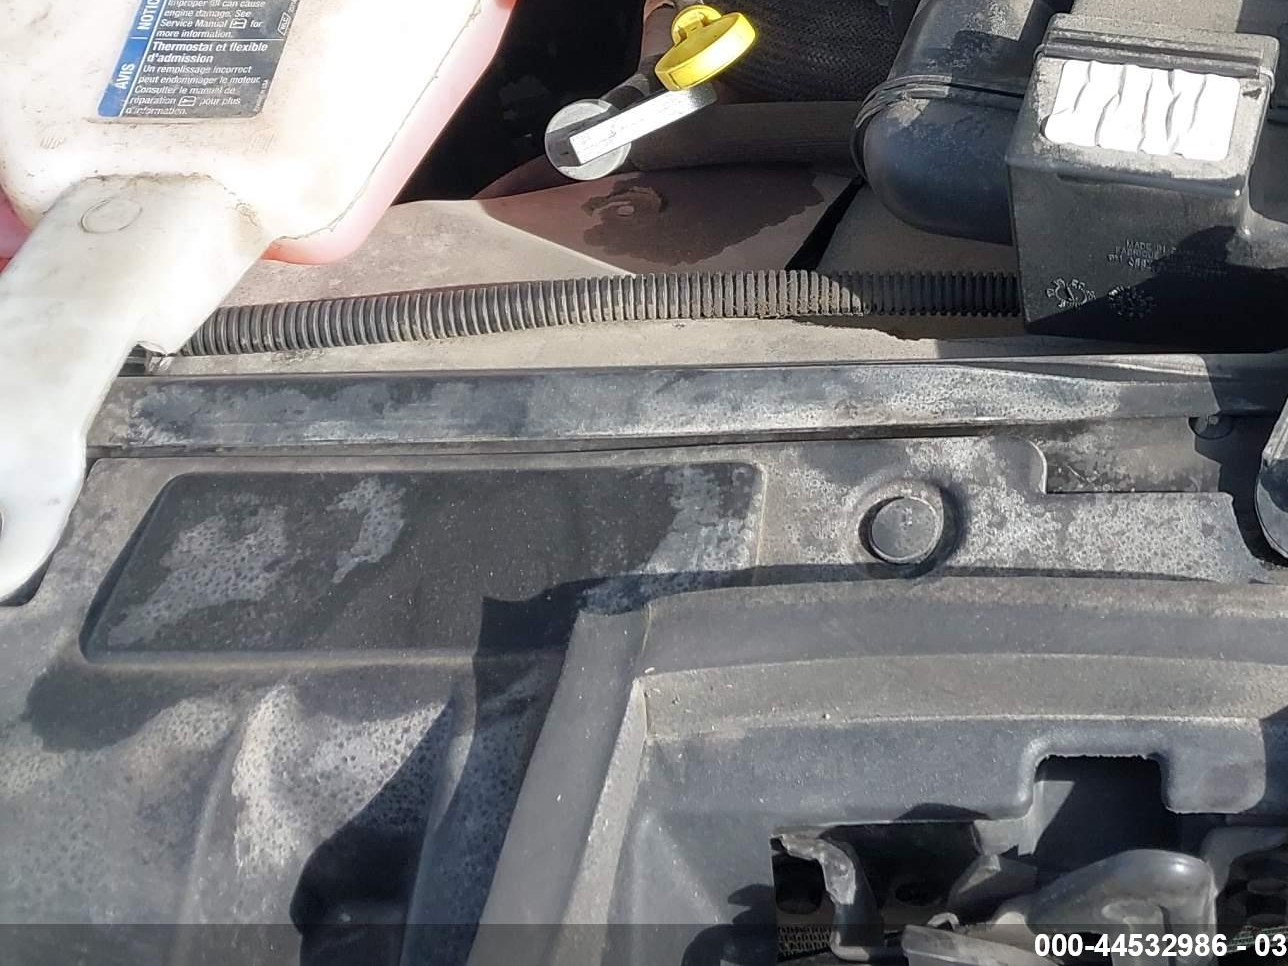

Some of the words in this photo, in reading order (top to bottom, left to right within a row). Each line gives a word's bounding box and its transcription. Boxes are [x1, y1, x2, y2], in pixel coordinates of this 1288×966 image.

[240, 0, 266, 8] cause
[164, 10, 194, 19] engine
[235, 9, 252, 18] See
[160, 19, 193, 28] Service
[195, 19, 228, 28] Manual
[250, 19, 264, 28] for
[156, 30, 180, 38] more
[181, 29, 233, 38] information.
[152, 41, 214, 52] Thermostat
[215, 42, 227, 52] et
[229, 41, 269, 52] flexible
[146, 54, 214, 63] d'admission
[142, 65, 155, 73] Un
[212, 65, 253, 74] incorrect
[114, 62, 136, 91] AVIS
[137, 76, 159, 85] peut
[160, 76, 218, 86] endommager
[219, 76, 228, 84] le
[134, 86, 176, 94] Consulter
[179, 86, 188, 94] le
